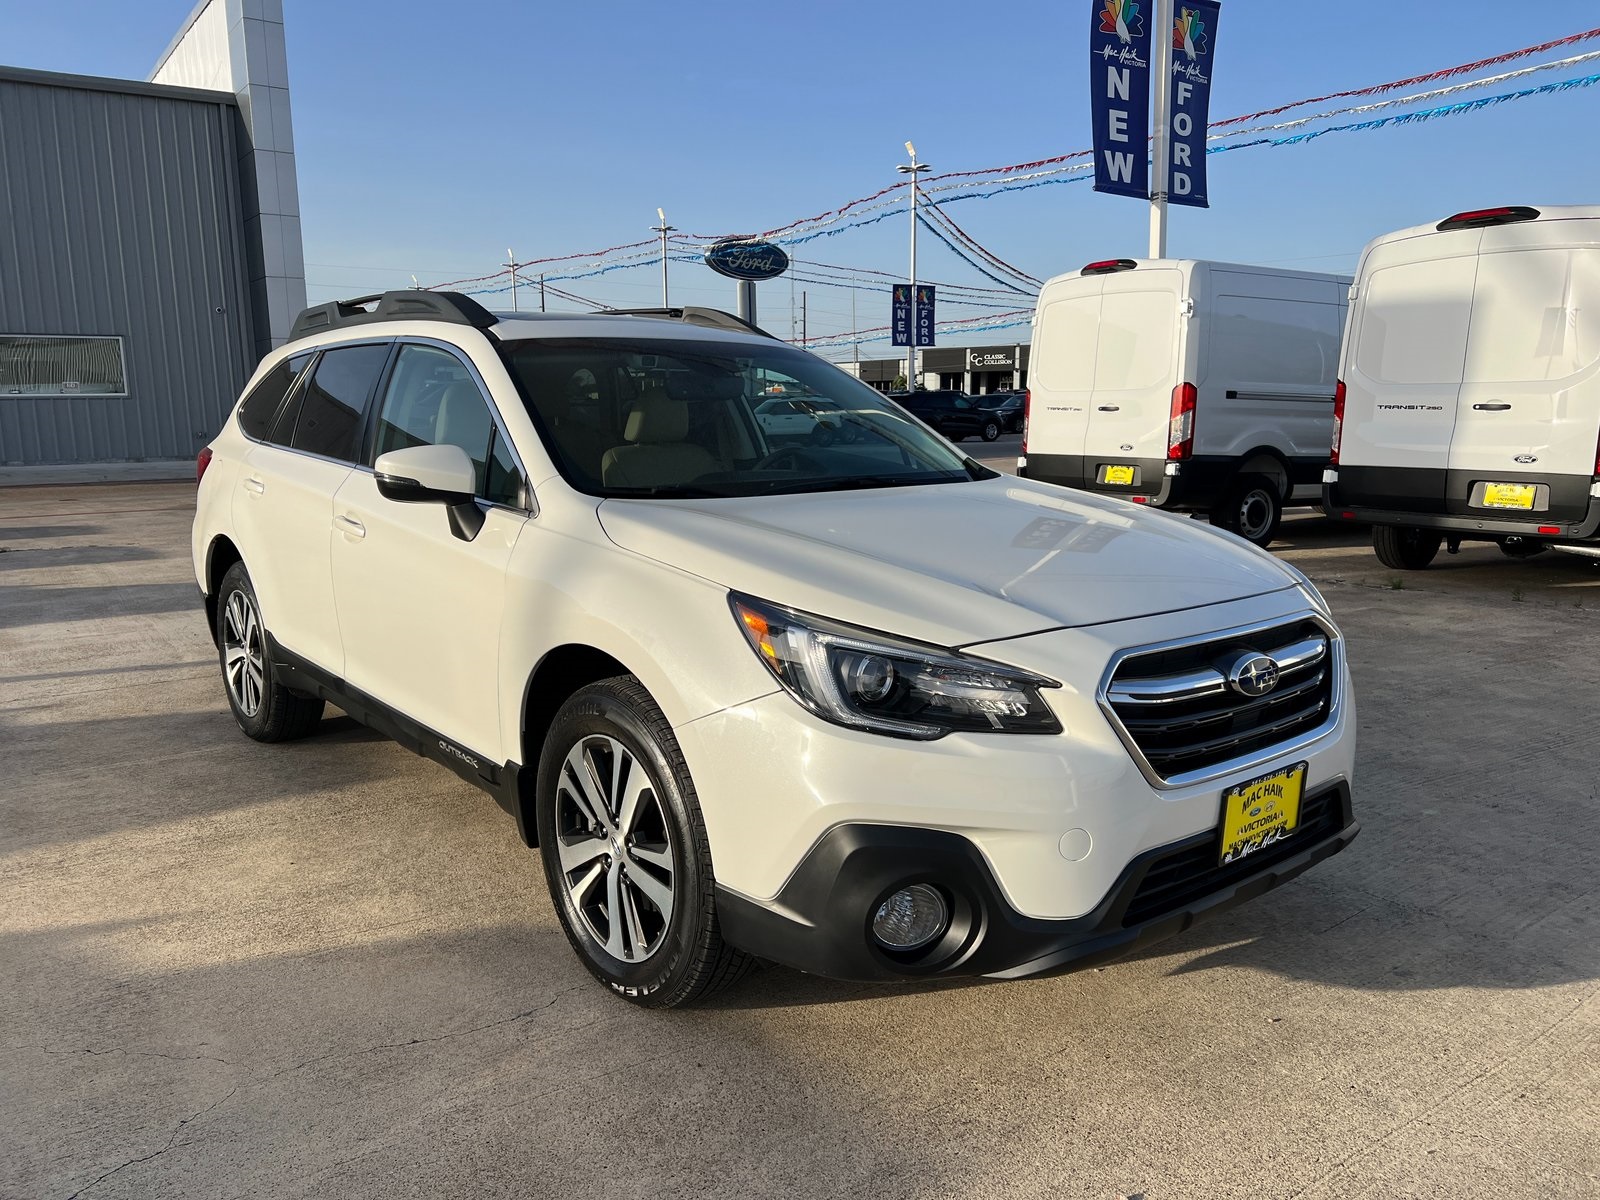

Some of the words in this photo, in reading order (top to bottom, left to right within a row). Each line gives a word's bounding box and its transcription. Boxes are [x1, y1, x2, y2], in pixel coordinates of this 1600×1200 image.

[1094, 44, 1119, 60] Mac
[1119, 46, 1147, 63] Haik
[1124, 60, 1147, 68] VICTORIA
[1172, 60, 1186, 75] Mac
[1186, 62, 1208, 79] Haik
[1103, 65, 1134, 184] NEW
[1173, 81, 1193, 196] FORD
[727, 245, 775, 271] Ford
[439, 740, 478, 769] OUTBACK
[1241, 787, 1263, 815] MAC
[1263, 783, 1284, 799] HAIK
[1239, 840, 1261, 859] Mac
[1261, 828, 1293, 849] Haik
